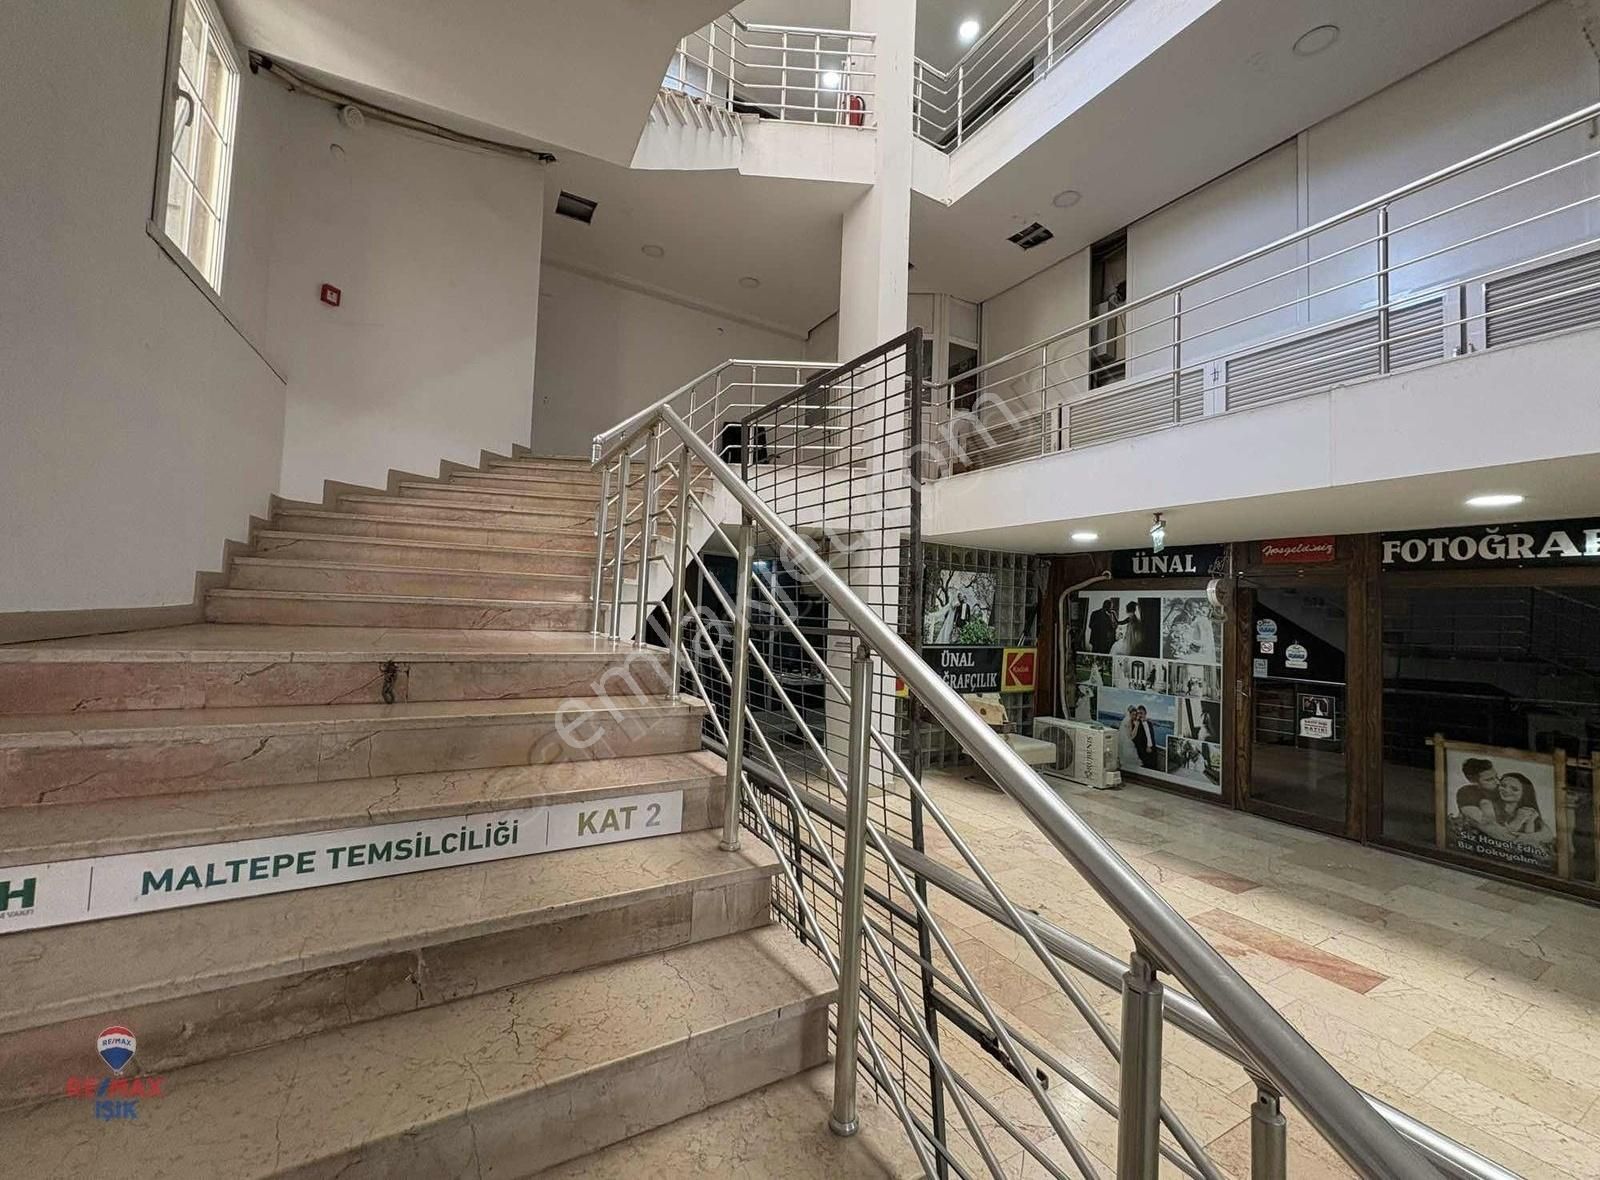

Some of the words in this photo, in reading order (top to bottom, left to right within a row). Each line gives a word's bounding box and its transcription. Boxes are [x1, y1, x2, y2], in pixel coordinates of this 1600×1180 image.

[1132, 552, 1197, 574] ÜNAL
[941, 650, 975, 667] ÜNAL
[942, 671, 998, 692] ĞRAFÇILIK
[141, 851, 315, 896] MALTEPE
[327, 819, 519, 870] TEMSİLCİLİĞİ
[577, 806, 637, 836] KAT
[645, 803, 662, 828] 2
[1457, 841, 1474, 850] Biz
[1460, 831, 1476, 840] Siz
[1479, 834, 1513, 850] Hayal
